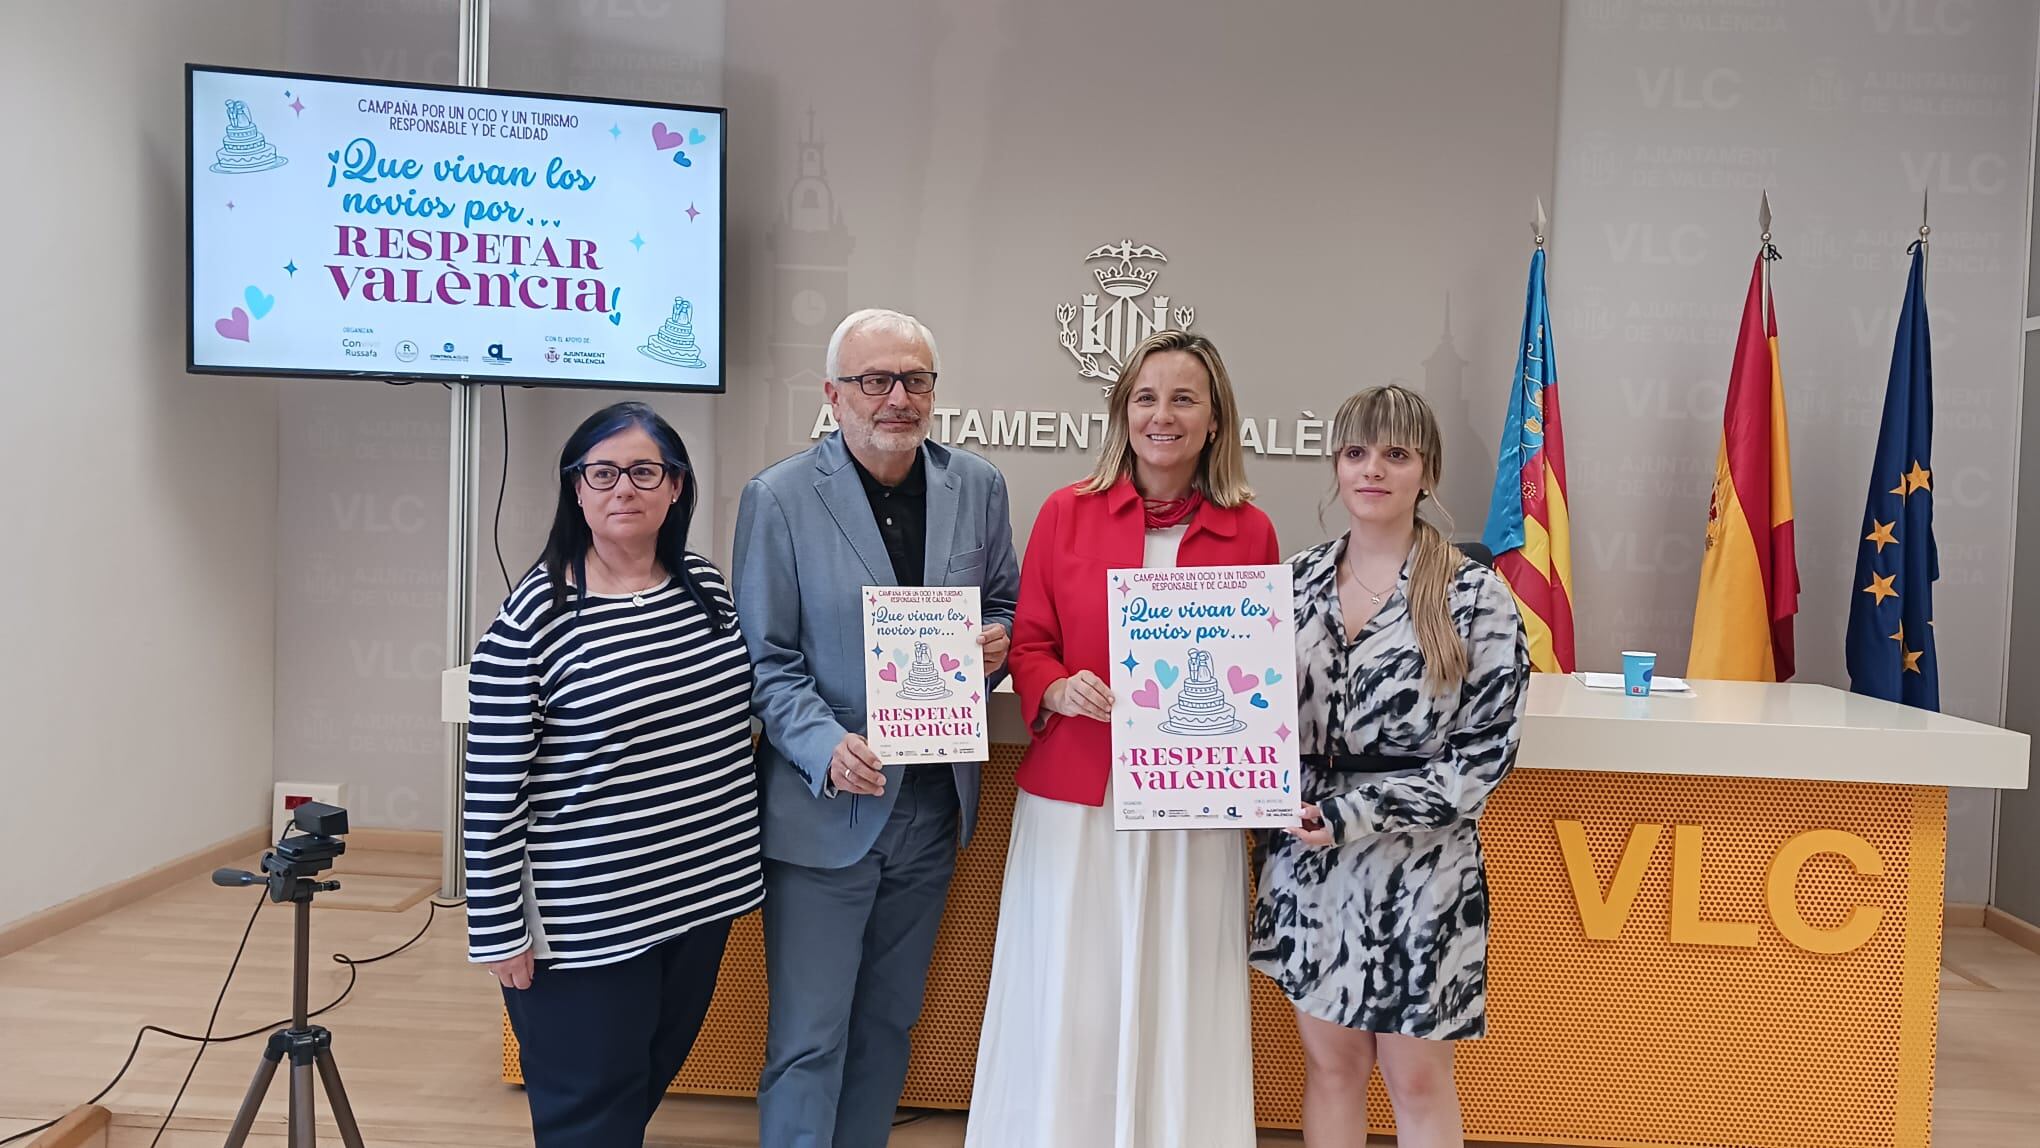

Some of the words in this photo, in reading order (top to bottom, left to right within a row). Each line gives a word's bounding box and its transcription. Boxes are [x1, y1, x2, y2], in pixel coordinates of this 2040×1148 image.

[358, 99, 418, 117] CAMPAÑA
[422, 104, 445, 119] POR
[449, 106, 464, 120] UN
[468, 107, 497, 122] OCIO
[501, 109, 509, 123] Y
[512, 111, 527, 125] UN
[531, 112, 579, 129] TURISMO
[390, 117, 467, 136] RESPONSABLE
[471, 123, 479, 137] Y
[483, 124, 496, 138] DE
[500, 125, 548, 141] CALIDAD
[434, 155, 536, 187] vivan
[546, 157, 596, 191] los
[343, 189, 455, 218] novios
[334, 225, 603, 270] RESPETAR
[810, 403, 1109, 450] ATAMENT
[1206, 582, 1216, 590] DE
[907, 610, 945, 622] vivan
[947, 608, 967, 621] los
[1178, 602, 1236, 619] vivan
[1241, 598, 1270, 617] los
[877, 624, 917, 636] novios
[1130, 623, 1192, 641] novios
[878, 706, 973, 721] RESPETAR
[1129, 745, 1279, 767] RESPETAR
[1553, 818, 1884, 955] VLC
